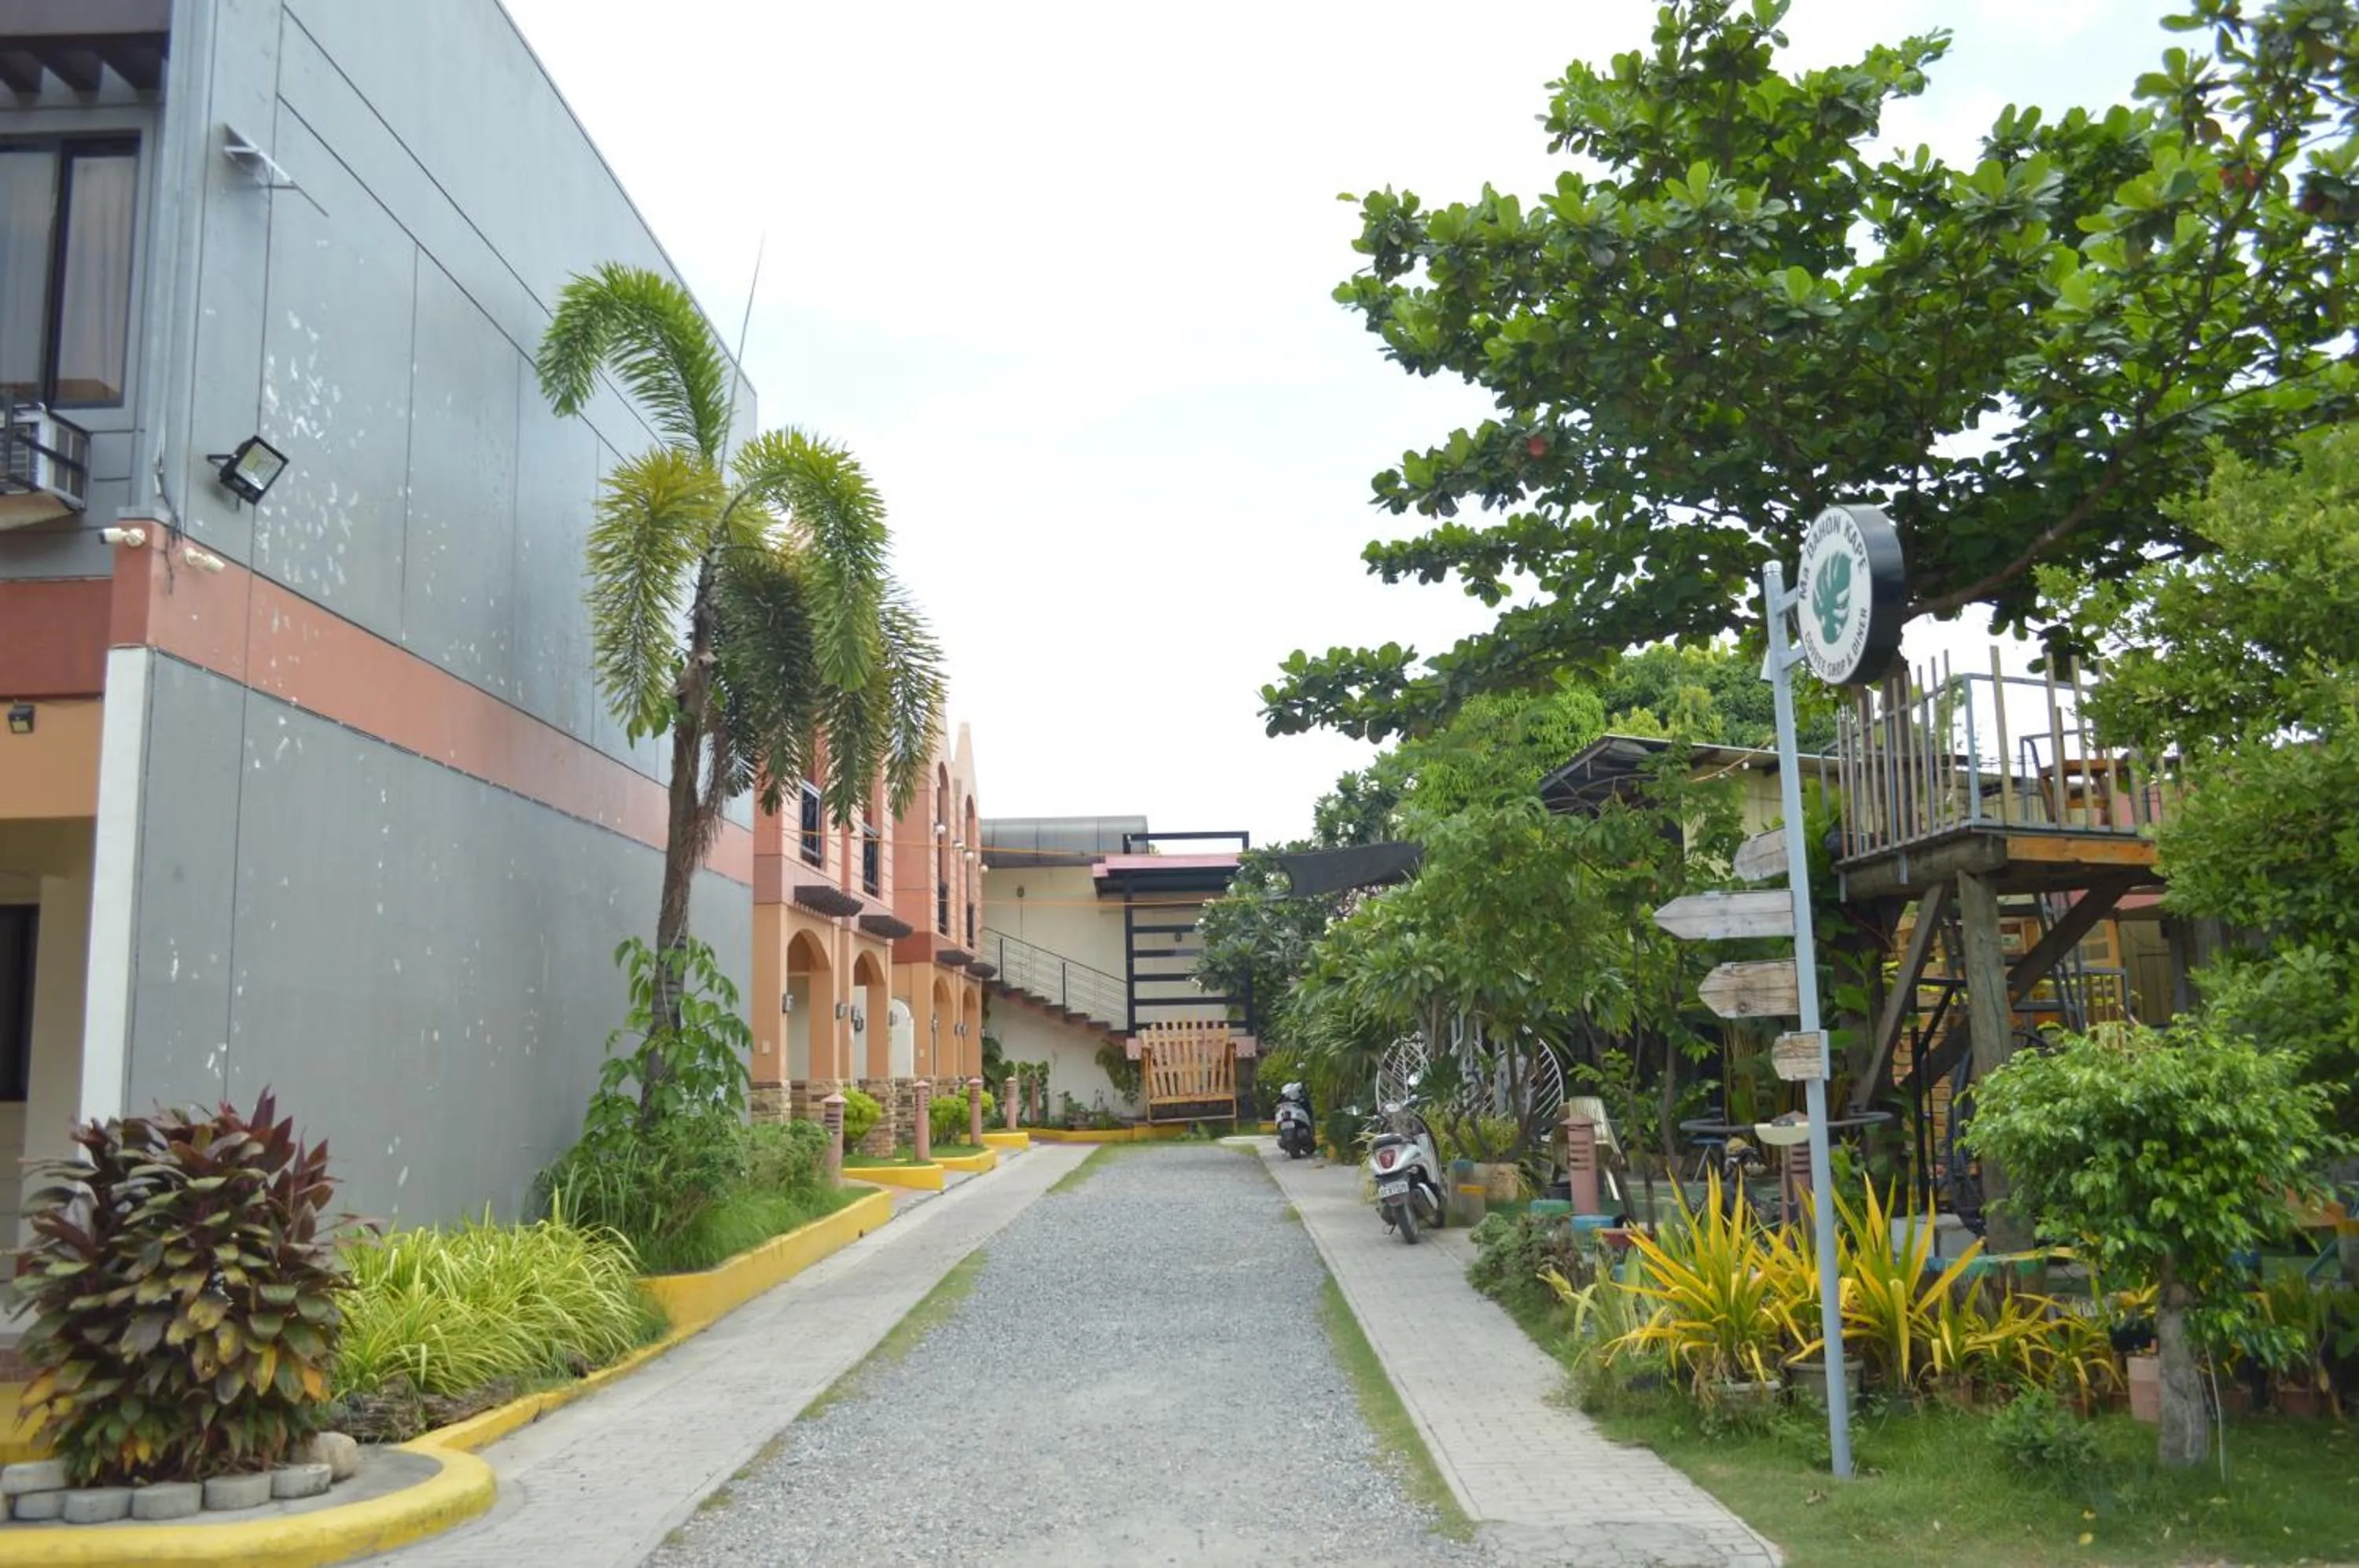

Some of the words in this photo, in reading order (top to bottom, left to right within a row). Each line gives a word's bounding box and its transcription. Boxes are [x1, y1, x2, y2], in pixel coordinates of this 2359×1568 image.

[1807, 515, 1841, 560] DAHON
[1845, 521, 1868, 574] KAPE
[1805, 631, 1826, 673] COFFEE
[1827, 661, 1846, 677] SHOP
[1852, 609, 1868, 655] DINER
